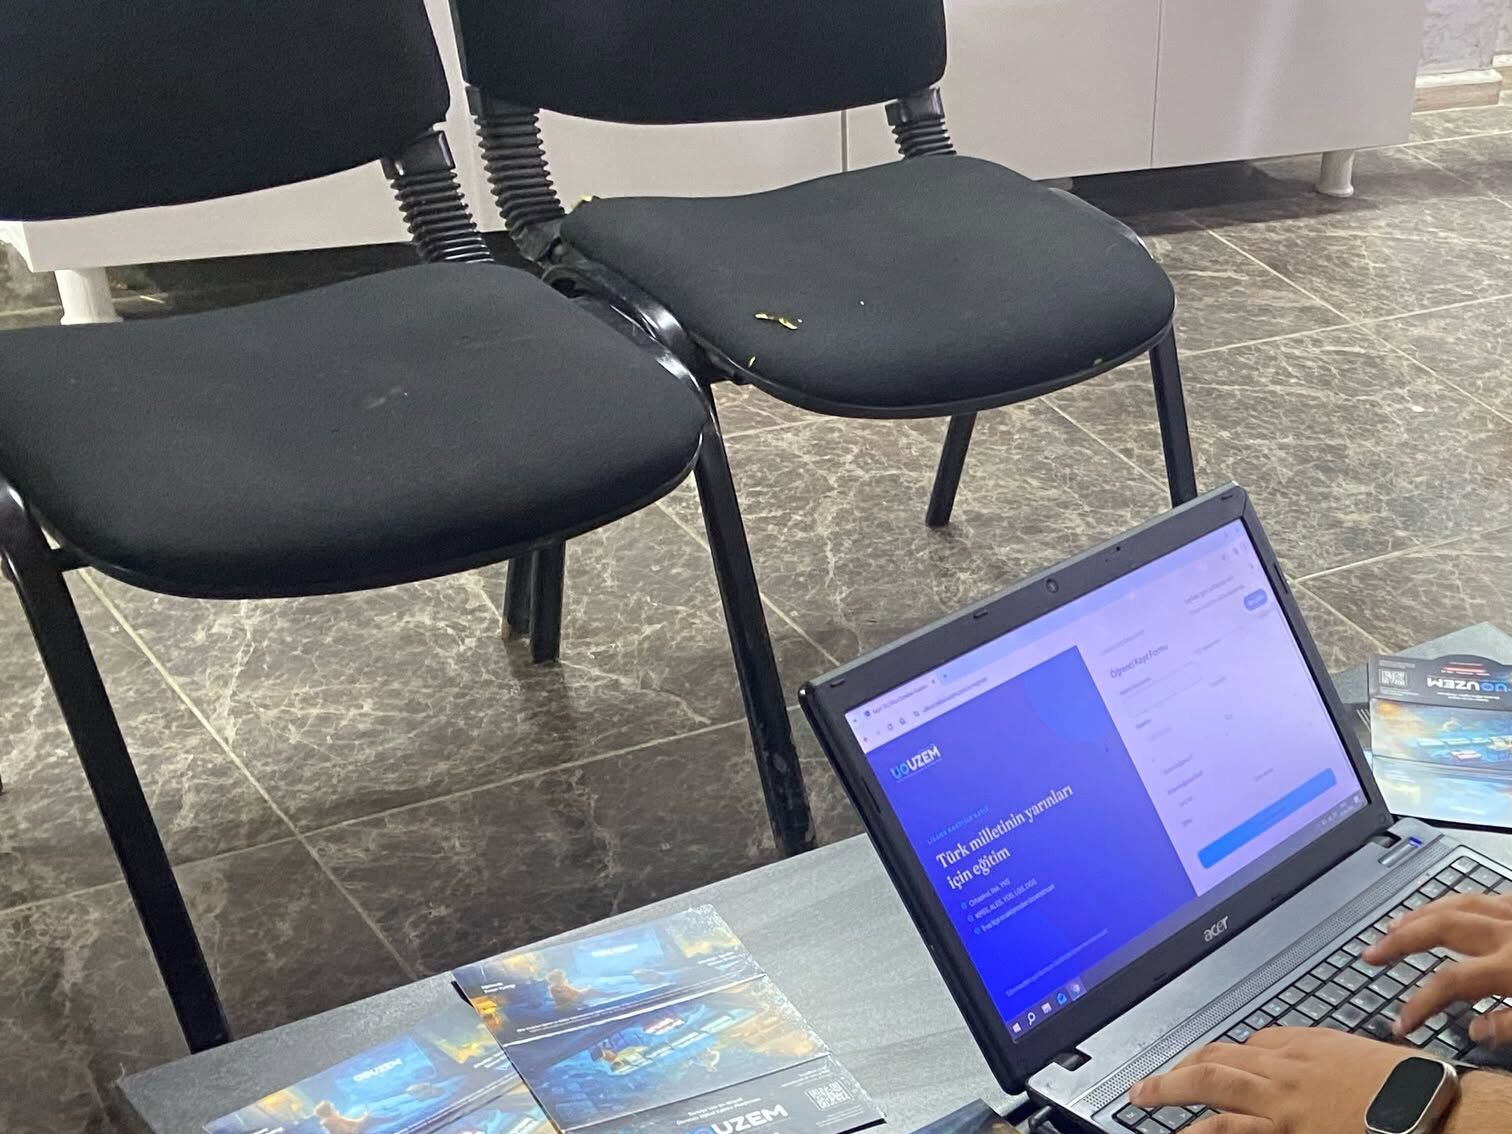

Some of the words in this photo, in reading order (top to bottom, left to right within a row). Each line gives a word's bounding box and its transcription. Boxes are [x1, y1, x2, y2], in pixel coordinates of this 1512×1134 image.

[936, 843, 970, 869] Türk
[969, 811, 1026, 852] milletinin
[1023, 784, 1074, 824] yarınları
[947, 867, 974, 890] için
[972, 847, 1011, 876] eğitim
[1203, 915, 1229, 942] acer
